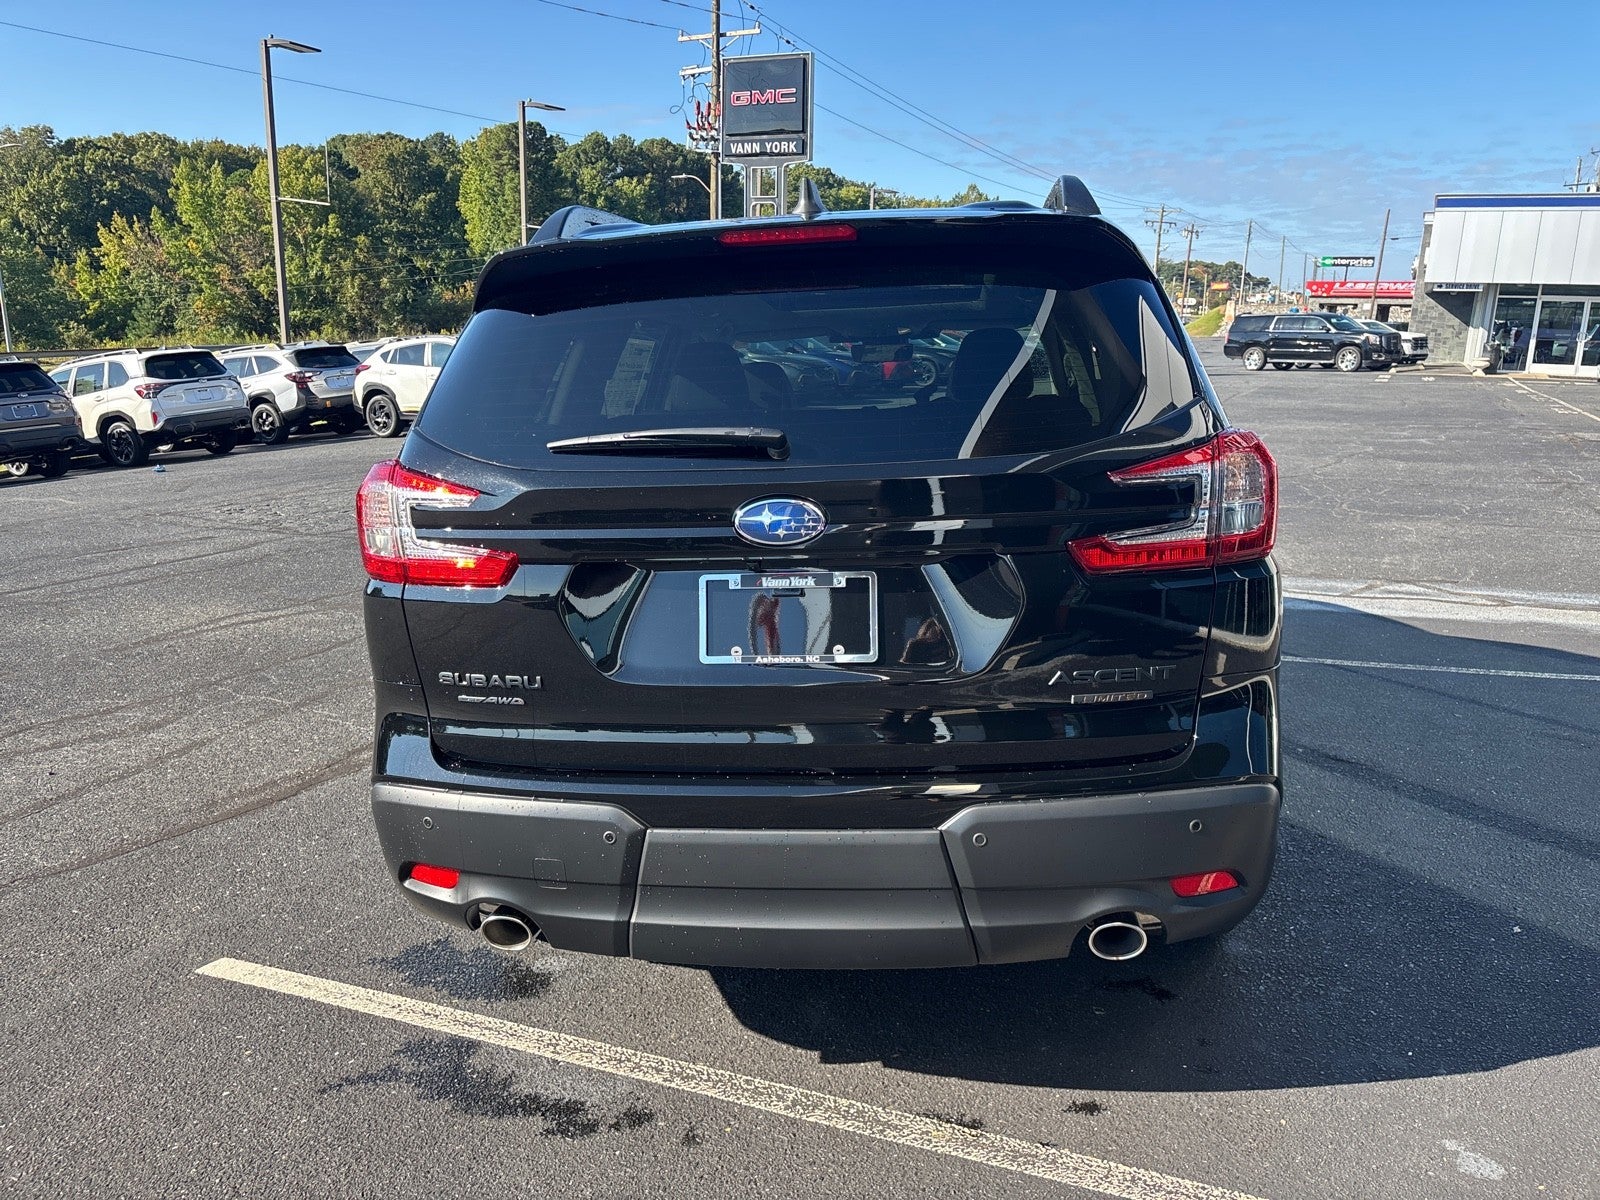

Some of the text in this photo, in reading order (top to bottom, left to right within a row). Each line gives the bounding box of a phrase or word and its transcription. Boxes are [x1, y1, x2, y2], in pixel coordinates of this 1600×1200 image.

[730, 88, 797, 107] GMC
[730, 140, 797, 154] VANN YORK
[1323, 257, 1374, 266] enterprise
[438, 671, 542, 689] SUBARU
[1047, 664, 1177, 686] ASCENT
[483, 696, 525, 705] AWD
[1081, 692, 1148, 704] LIMITED
